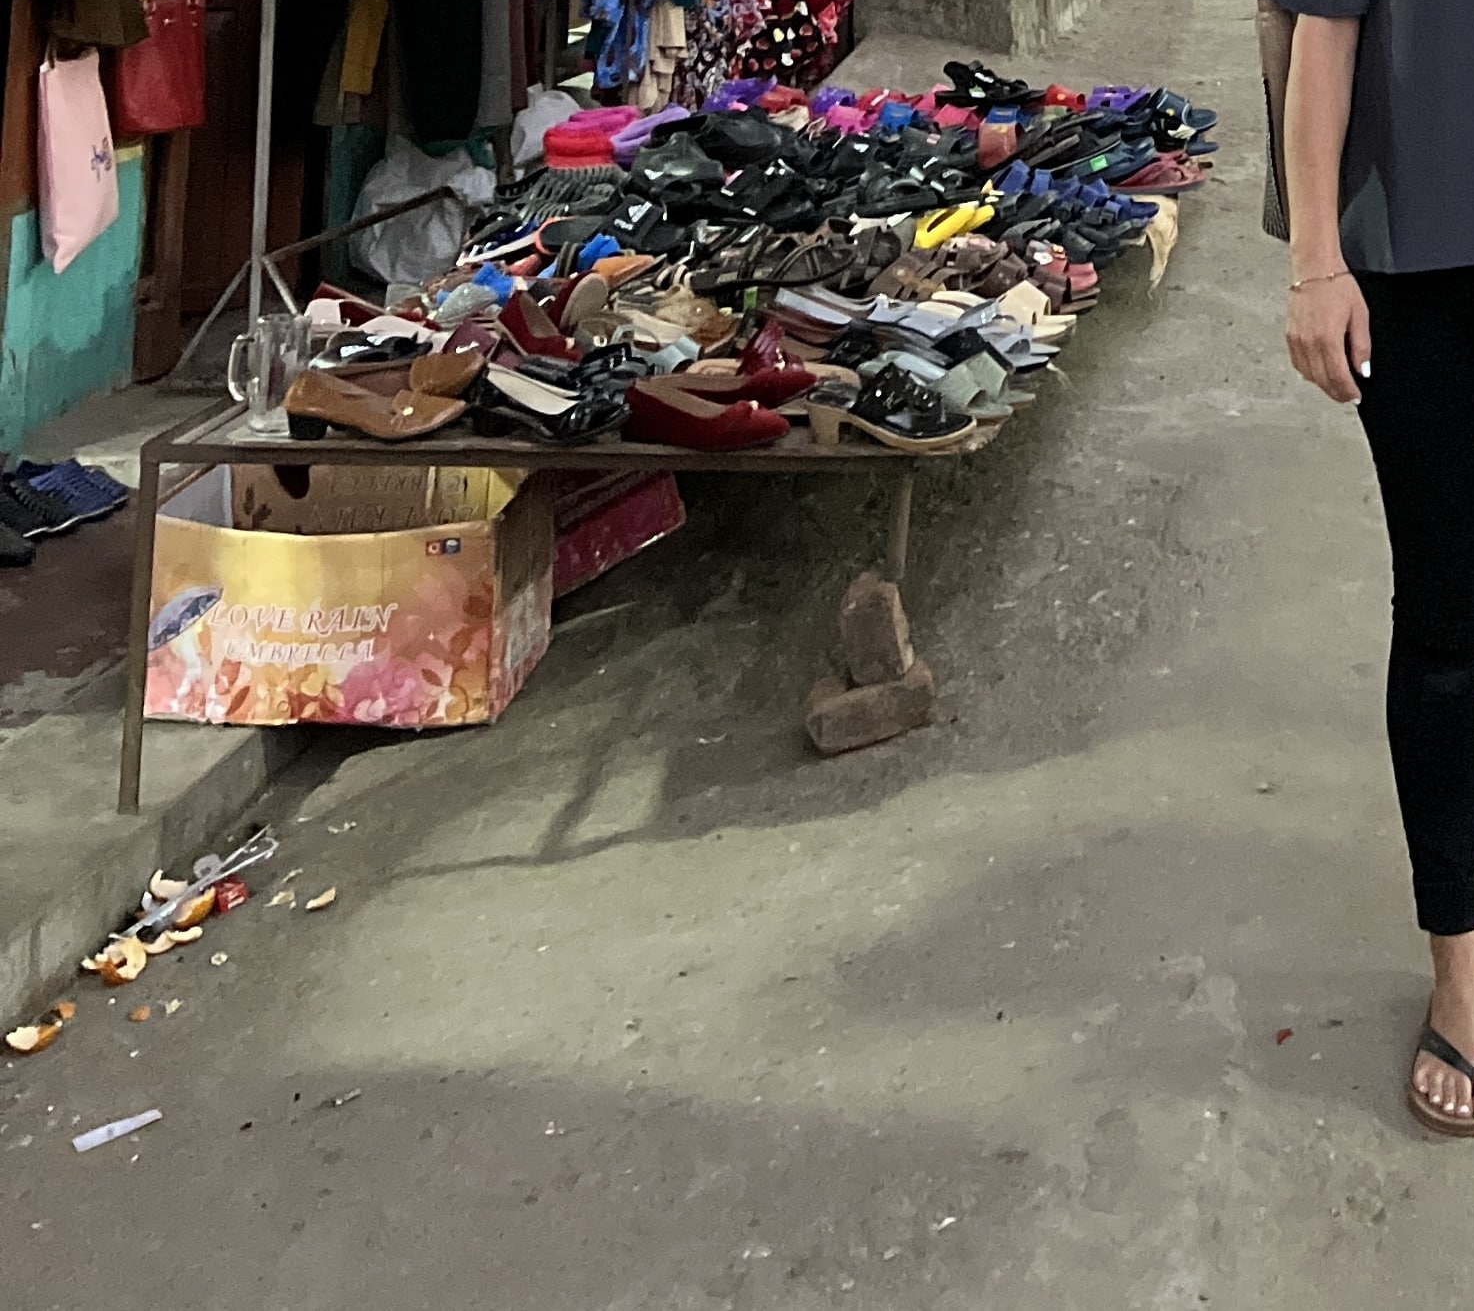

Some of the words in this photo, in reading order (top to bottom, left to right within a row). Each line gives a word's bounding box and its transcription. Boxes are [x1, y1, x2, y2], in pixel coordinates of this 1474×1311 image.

[207, 601, 297, 633] LOVE
[300, 602, 399, 638] RAIN
[224, 637, 376, 666] UMBRELLA
